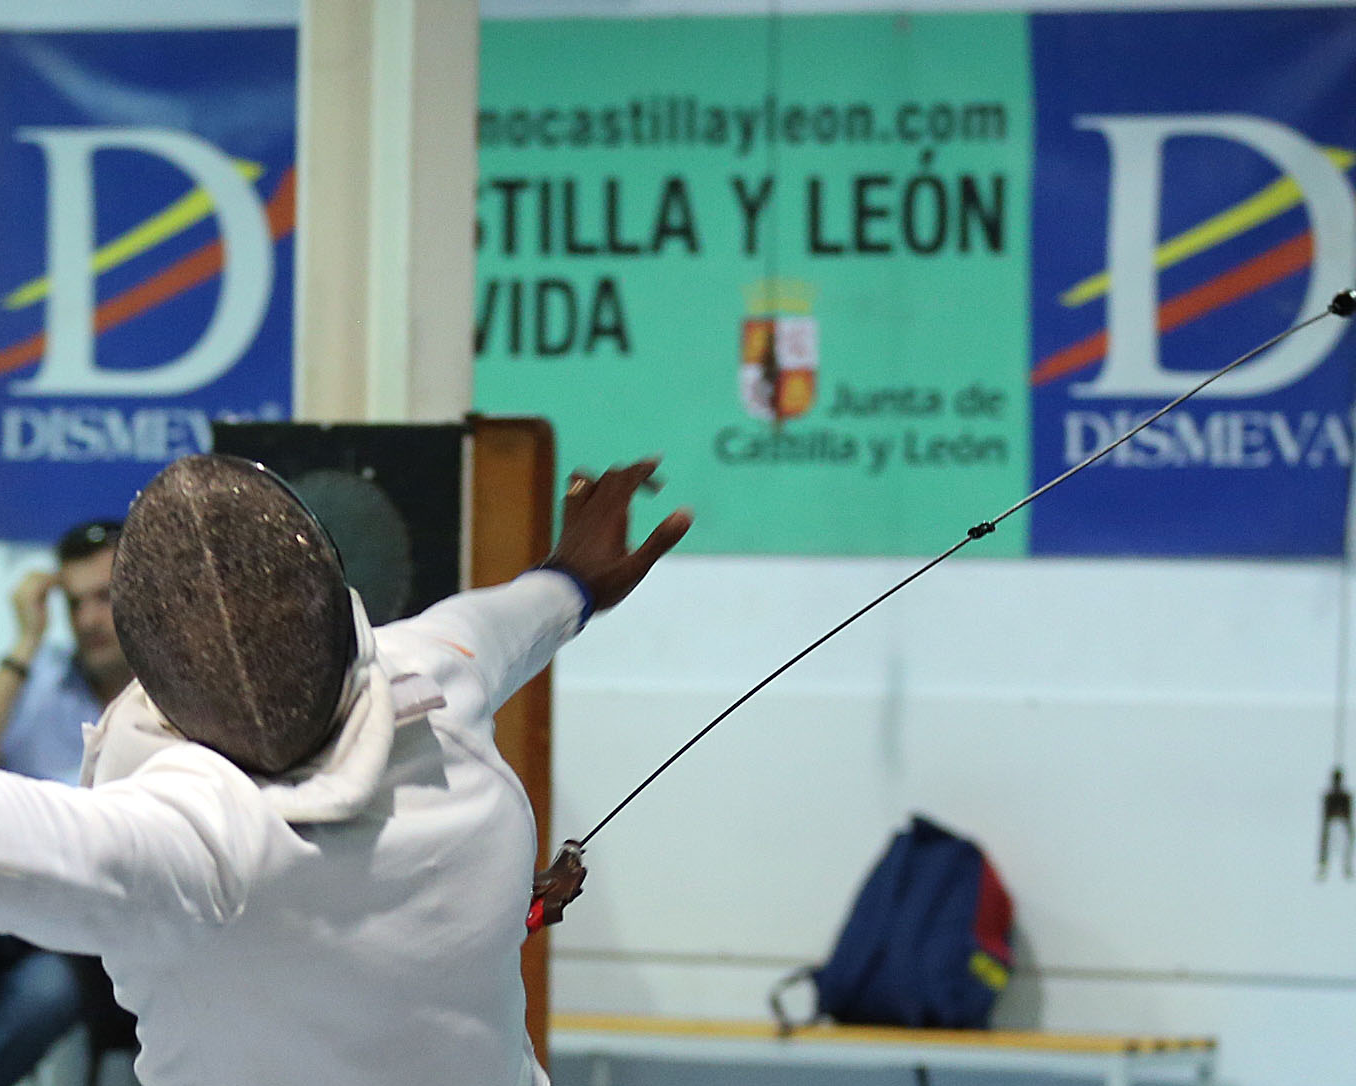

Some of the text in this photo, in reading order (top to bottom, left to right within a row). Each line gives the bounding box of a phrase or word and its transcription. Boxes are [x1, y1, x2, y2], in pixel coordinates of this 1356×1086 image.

[728, 176, 774, 258] Y
[806, 150, 1008, 257] LEÓN
[828, 381, 1005, 420] Junta de
[1, 404, 284, 464] DISMEV
[866, 436, 892, 474] y
[903, 427, 1008, 467] León
